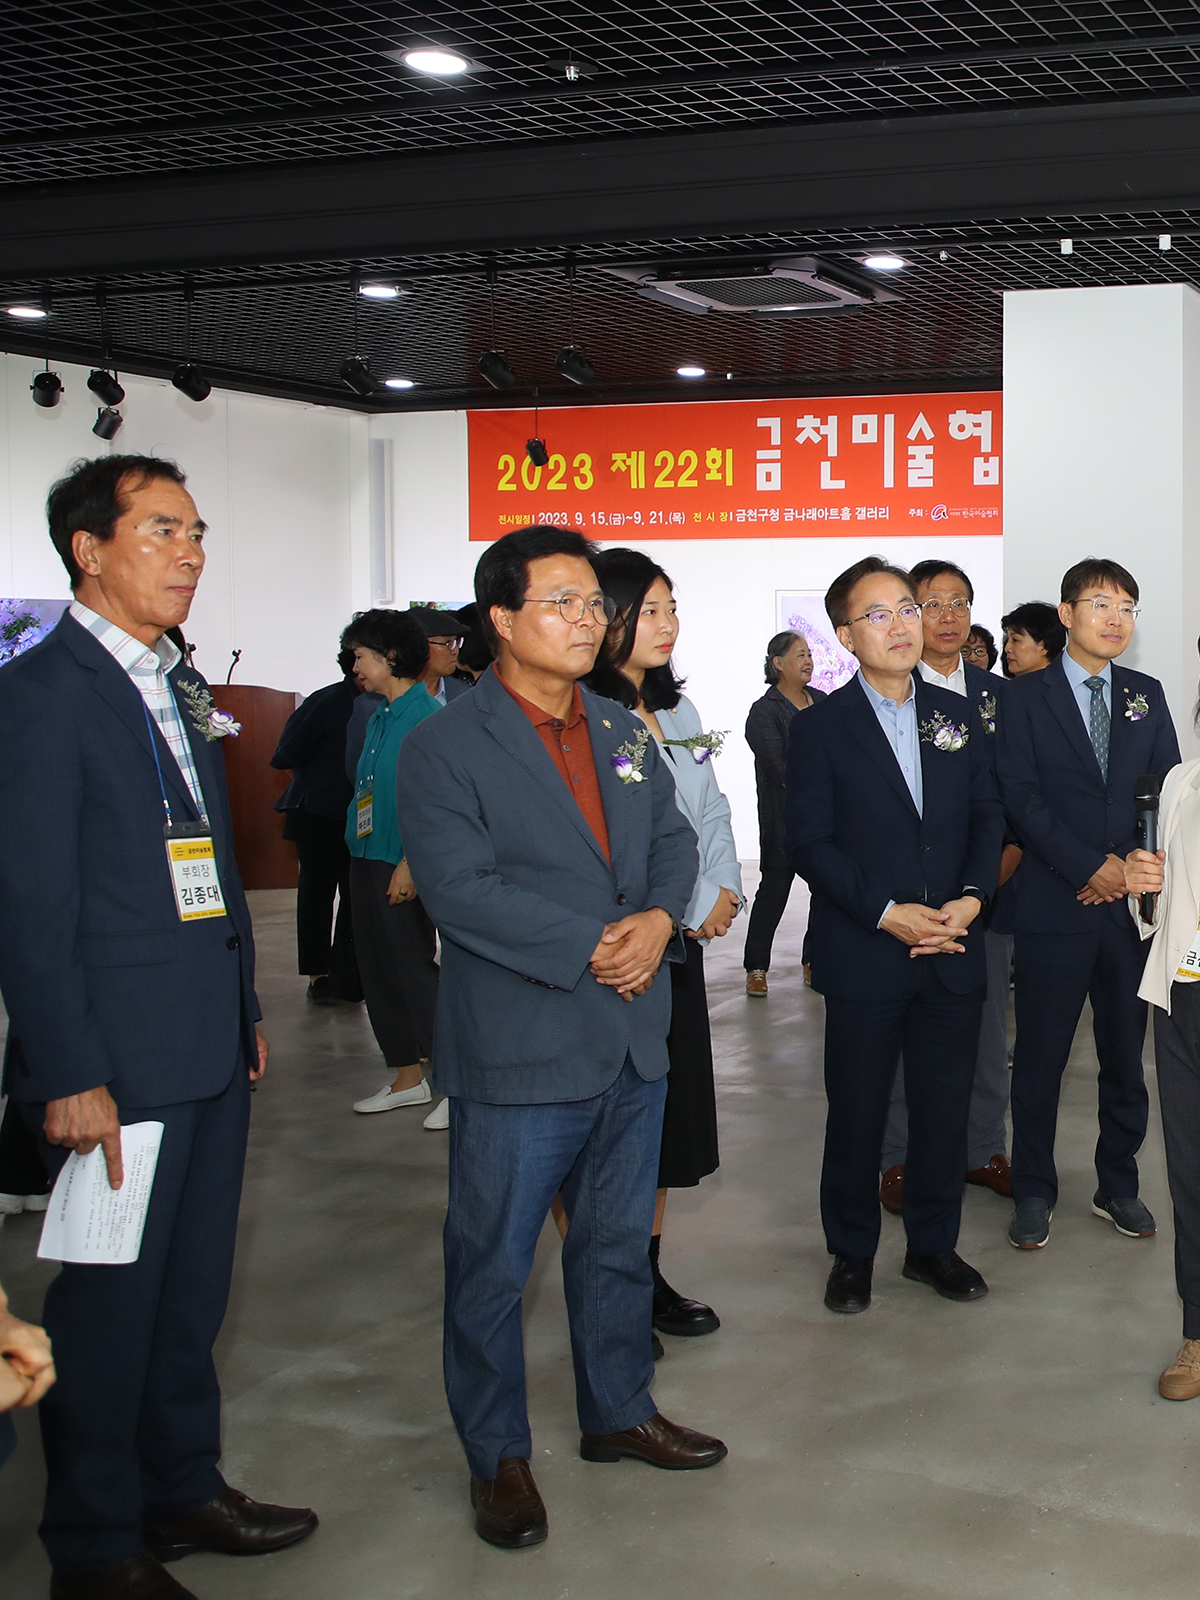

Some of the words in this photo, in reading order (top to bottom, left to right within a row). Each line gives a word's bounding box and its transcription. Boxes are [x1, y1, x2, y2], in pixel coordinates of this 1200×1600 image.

[496, 453, 595, 491] 2023
[610, 447, 734, 490] 제22회
[735, 508, 780, 523] 금천구청
[783, 506, 852, 521] 금나래아트홀
[854, 506, 890, 520] 갤러리
[182, 864, 210, 879] 부회장
[181, 884, 220, 906] 김종대
